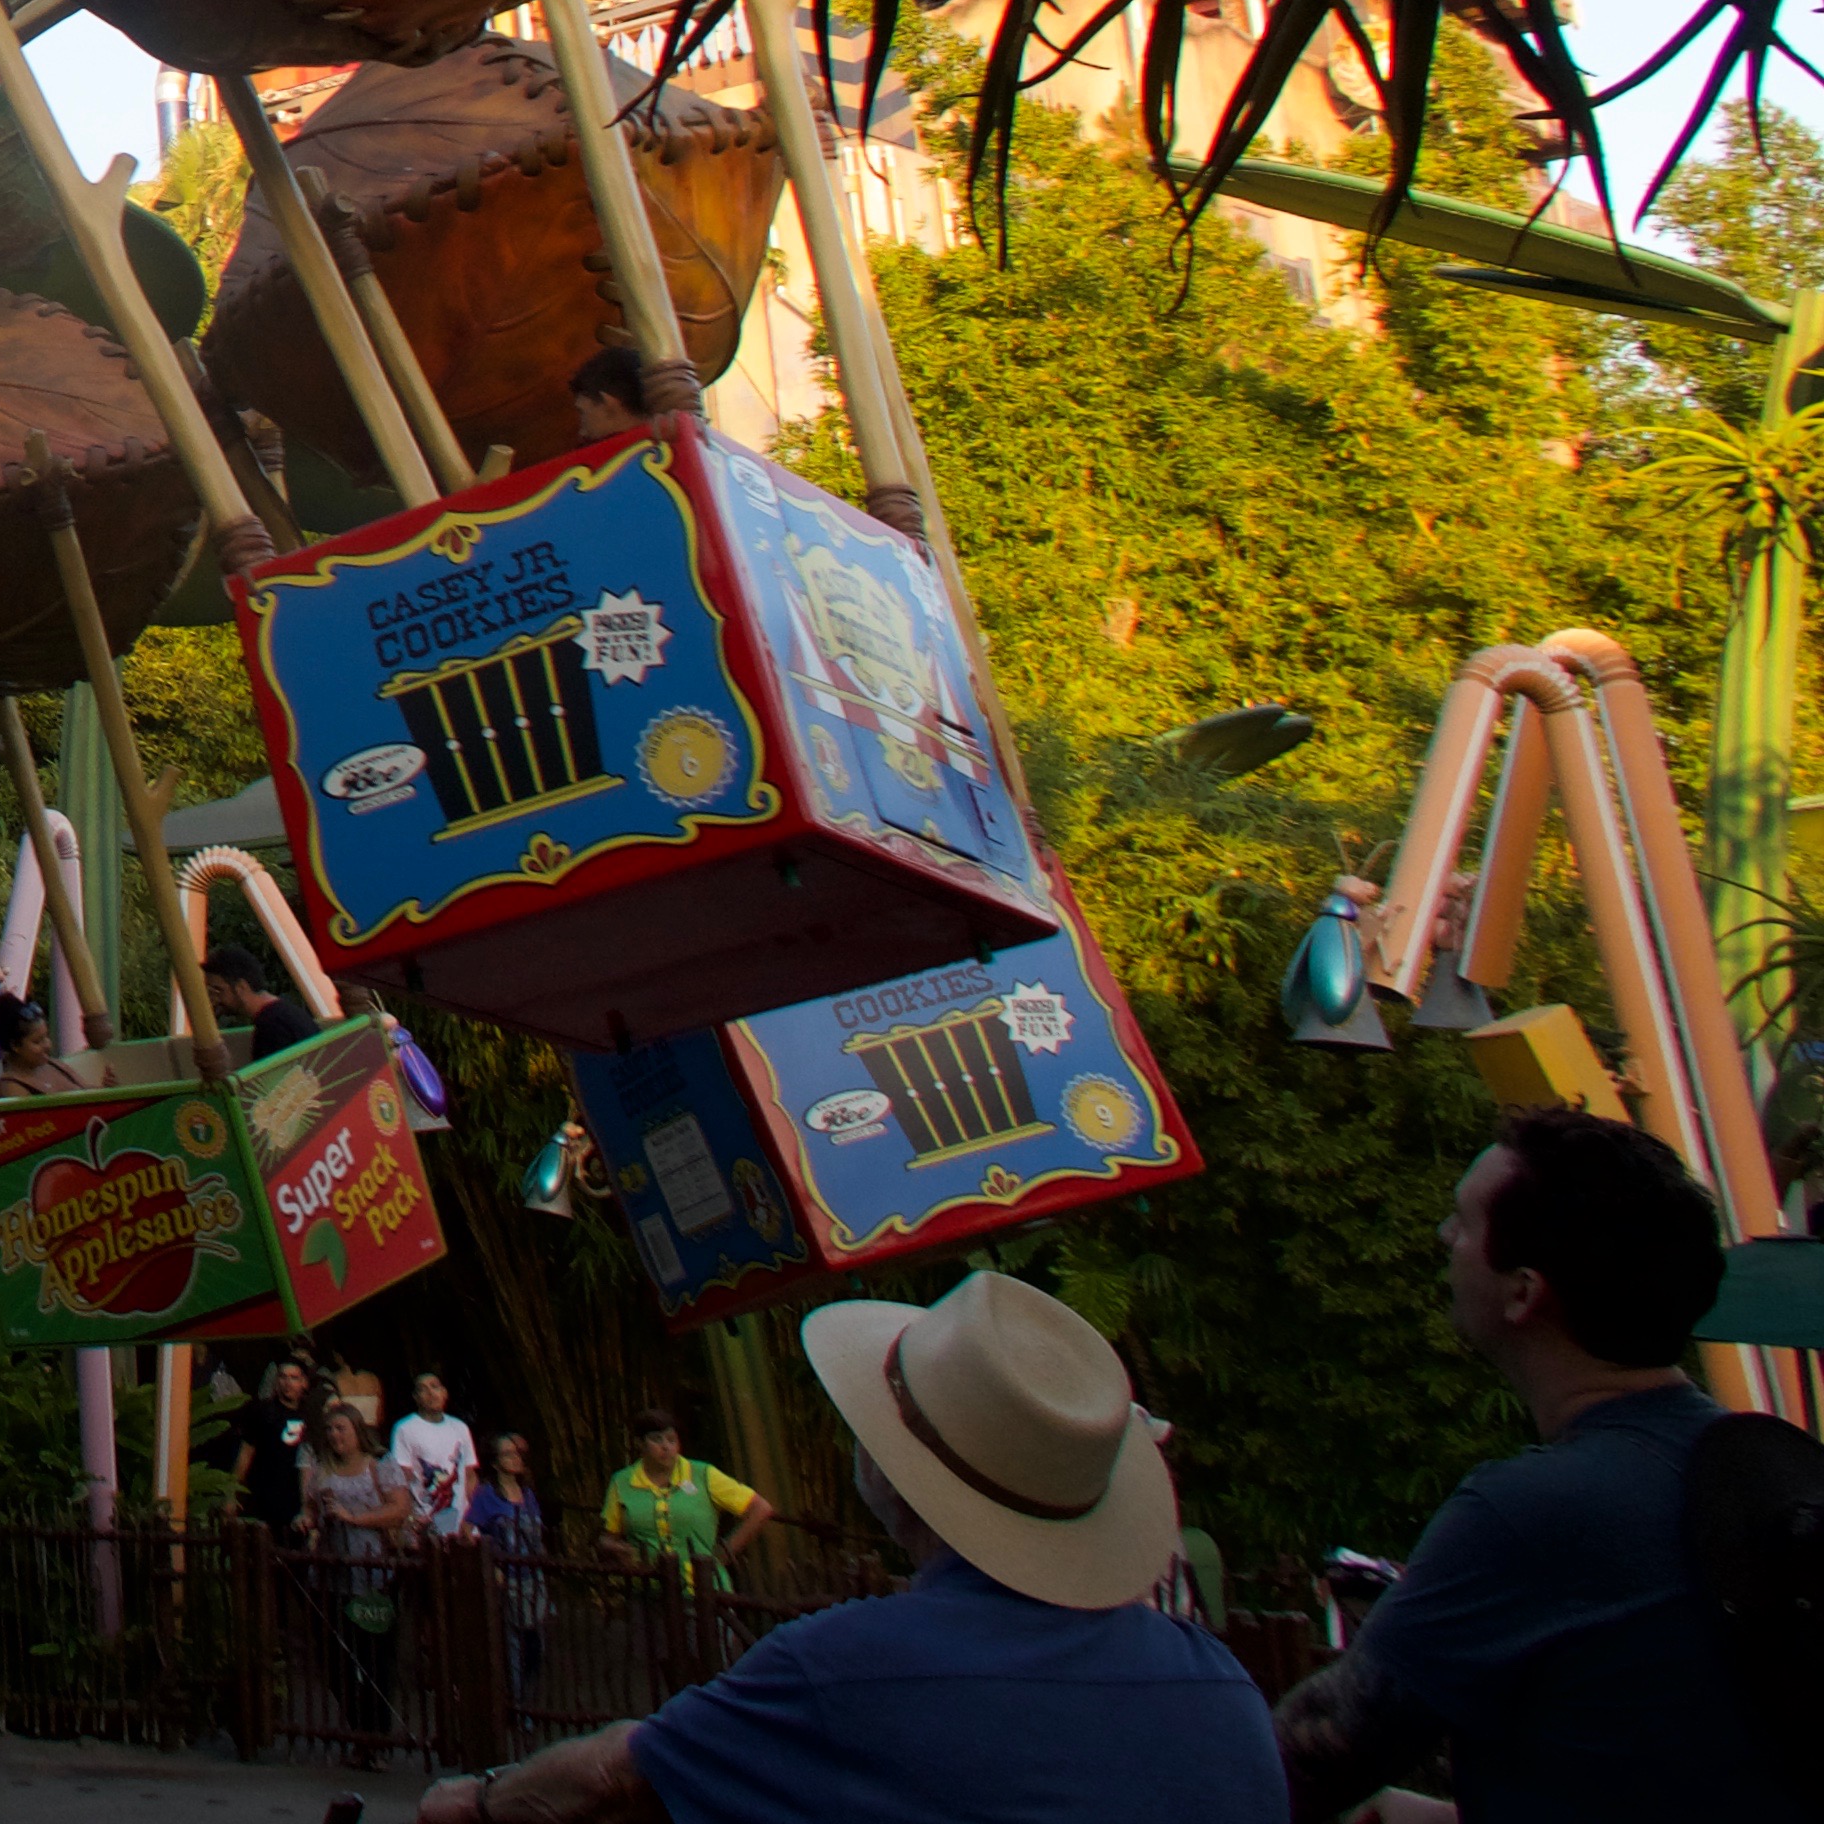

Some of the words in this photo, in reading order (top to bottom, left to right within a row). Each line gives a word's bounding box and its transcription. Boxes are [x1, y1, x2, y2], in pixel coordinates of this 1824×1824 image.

[366, 561, 494, 631] CASEY
[374, 572, 574, 668] COOKIES
[596, 644, 652, 664] FUN!
[832, 963, 995, 1030] COOKIES
[1018, 1023, 1060, 1037] FUN!
[1095, 1105, 1114, 1128] 9
[276, 1126, 356, 1234] Super
[333, 1141, 400, 1231] Snack
[366, 1172, 423, 1248] Pack
[38, 1190, 239, 1313] Applesauce
